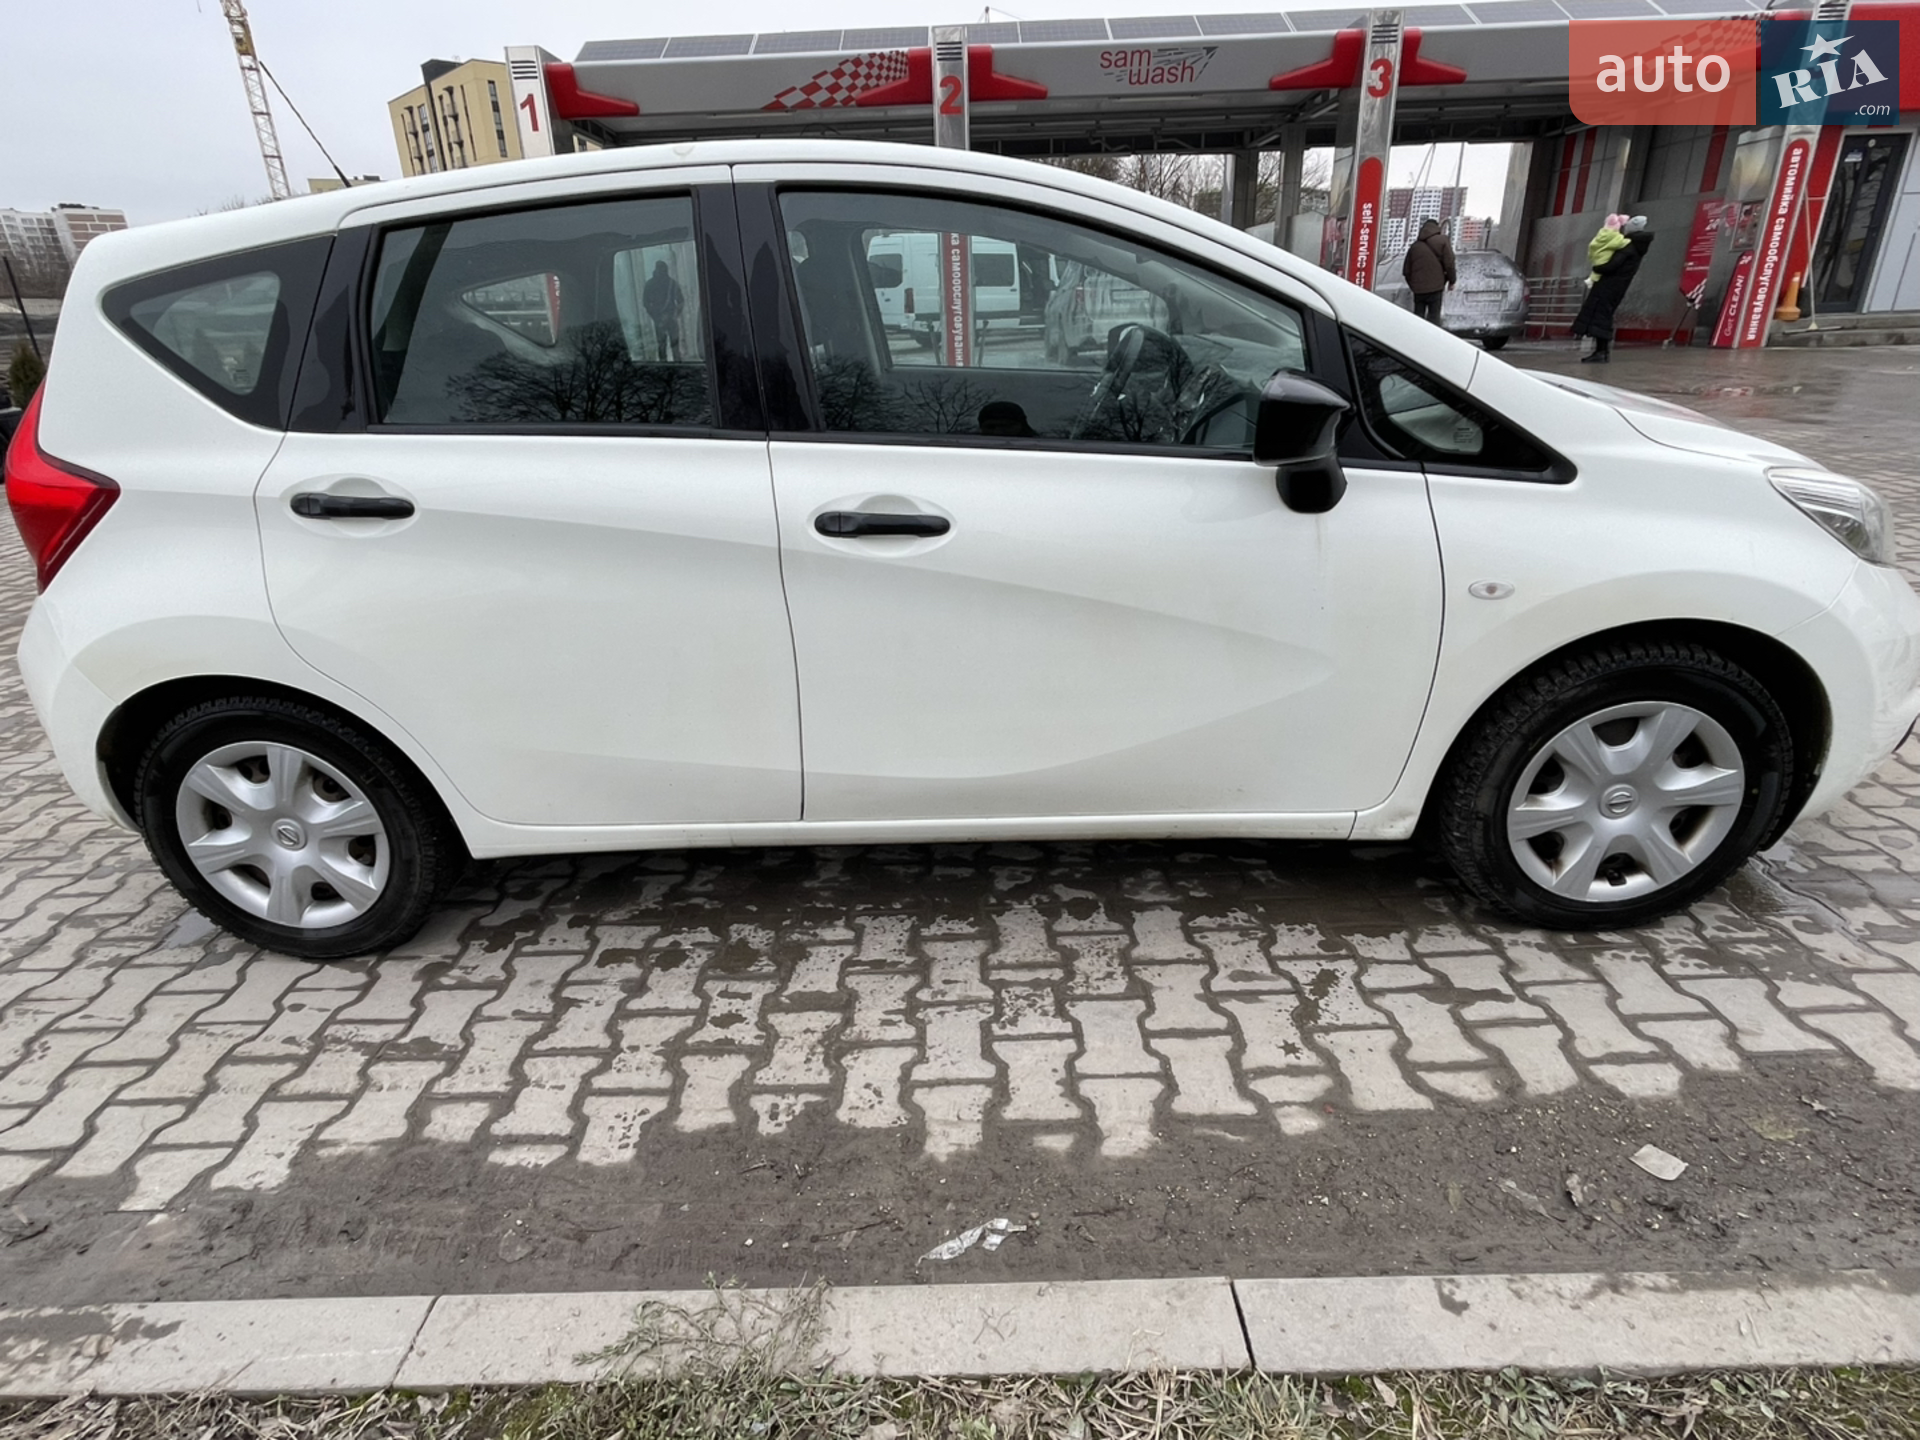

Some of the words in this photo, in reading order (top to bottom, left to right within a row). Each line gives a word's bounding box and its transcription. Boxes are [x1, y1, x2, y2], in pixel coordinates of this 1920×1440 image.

[1100, 49, 1151, 69] sam
[1128, 60, 1195, 85] wash
[1368, 58, 1392, 98] 3
[519, 93, 540, 132] 1
[940, 75, 963, 115] 2
[1778, 147, 1803, 215] автомийка
[1356, 203, 1373, 268] self-service
[1355, 271, 1366, 289] ca
[1747, 217, 1786, 341] самообслуговування
